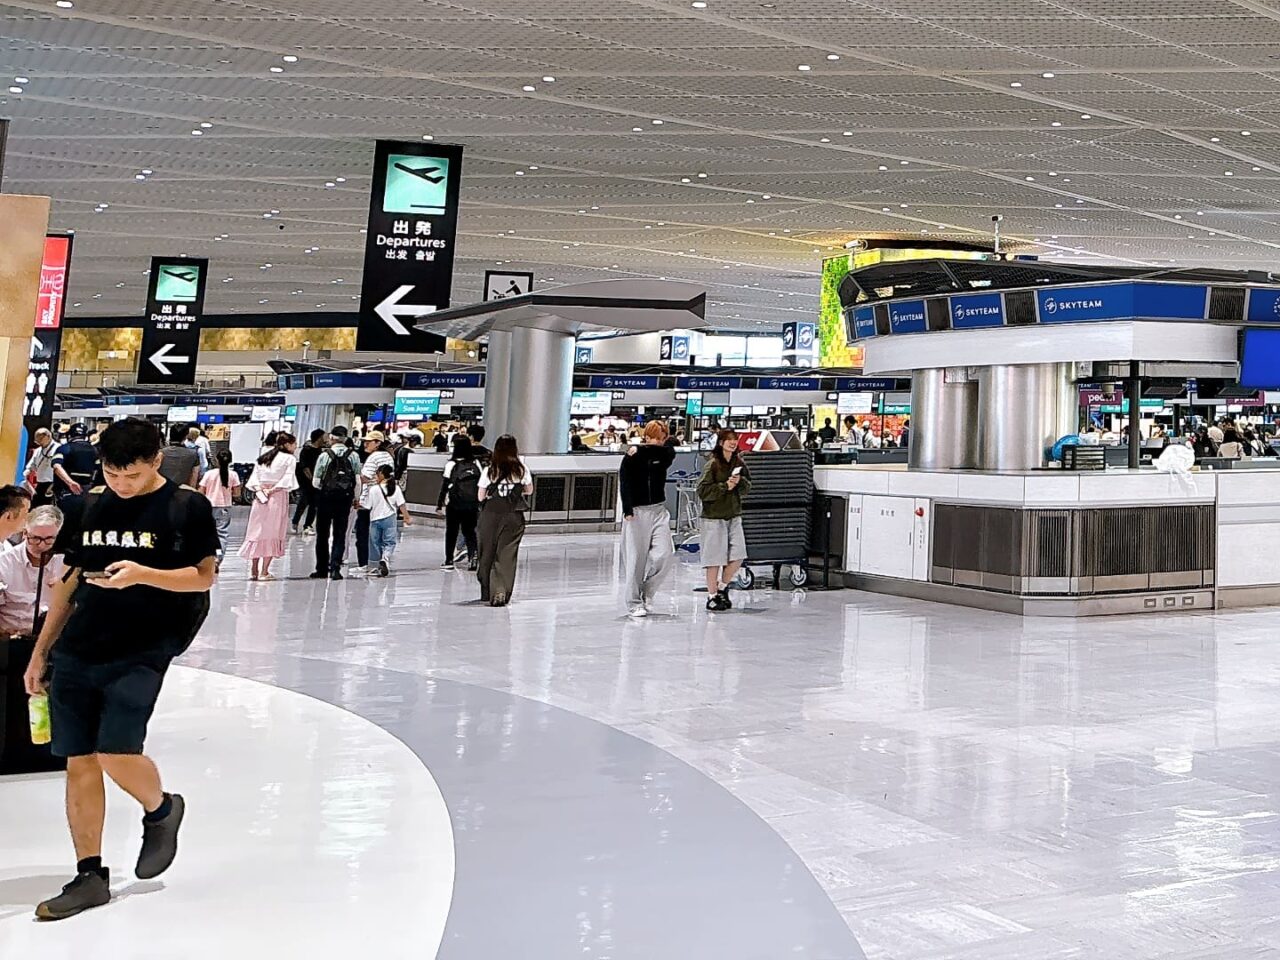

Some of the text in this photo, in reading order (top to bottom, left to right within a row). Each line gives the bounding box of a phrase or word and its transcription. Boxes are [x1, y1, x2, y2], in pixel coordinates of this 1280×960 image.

[392, 219, 432, 236] 出発
[376, 234, 446, 249] Departures
[385, 248, 408, 260] 出发
[1060, 300, 1102, 310] SKYTEAM
[965, 306, 999, 316] SKYTEAM
[151, 313, 196, 322] Departures
[900, 313, 924, 322] SKYTEAM
